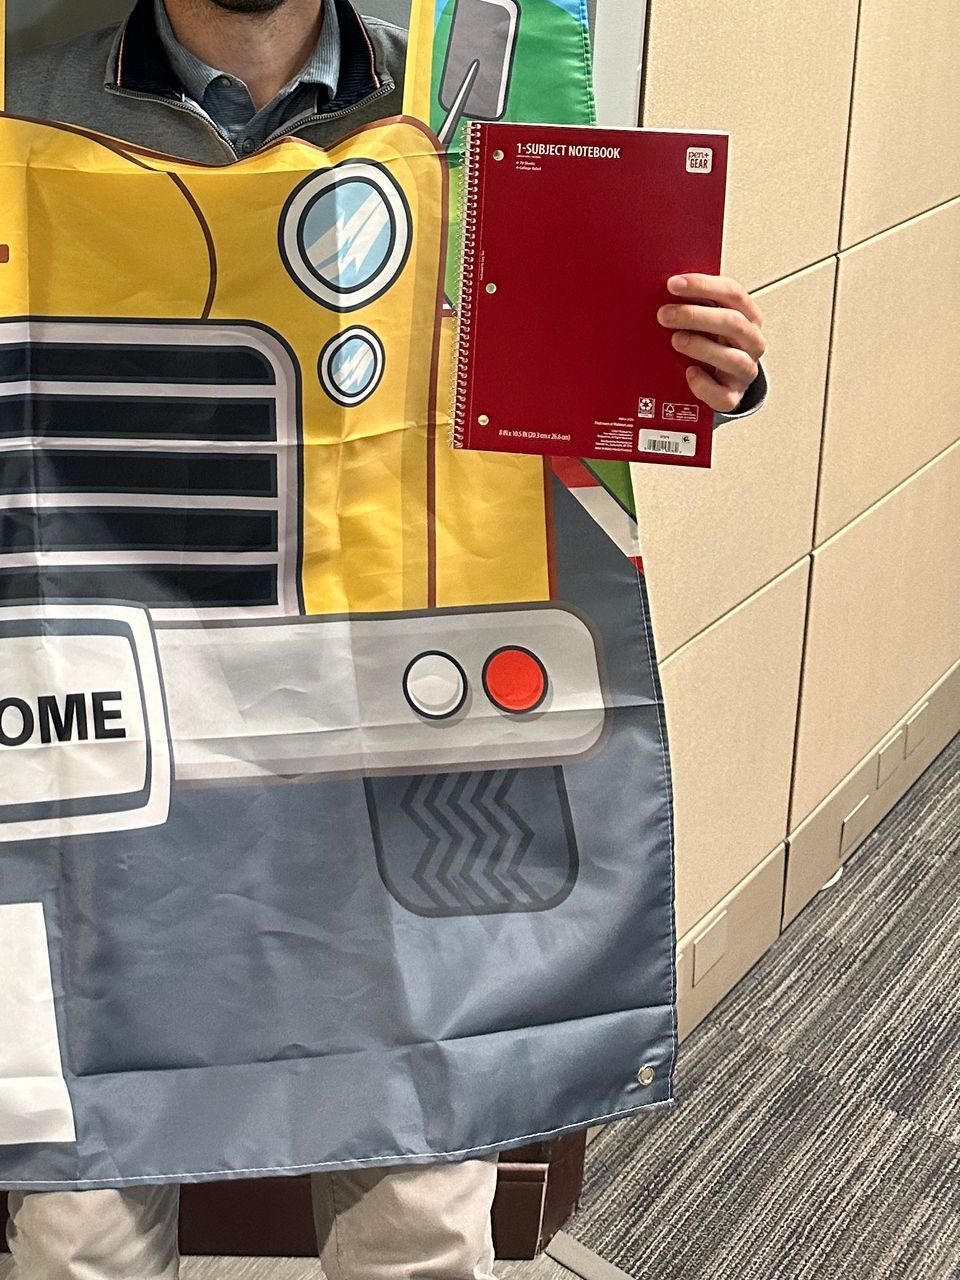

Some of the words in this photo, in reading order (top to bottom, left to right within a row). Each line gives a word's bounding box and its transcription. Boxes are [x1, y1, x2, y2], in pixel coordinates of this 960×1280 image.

[516, 143, 567, 156] 1-SUBJECT
[568, 145, 620, 159] NOTEBOOK
[690, 158, 708, 169] GEAR
